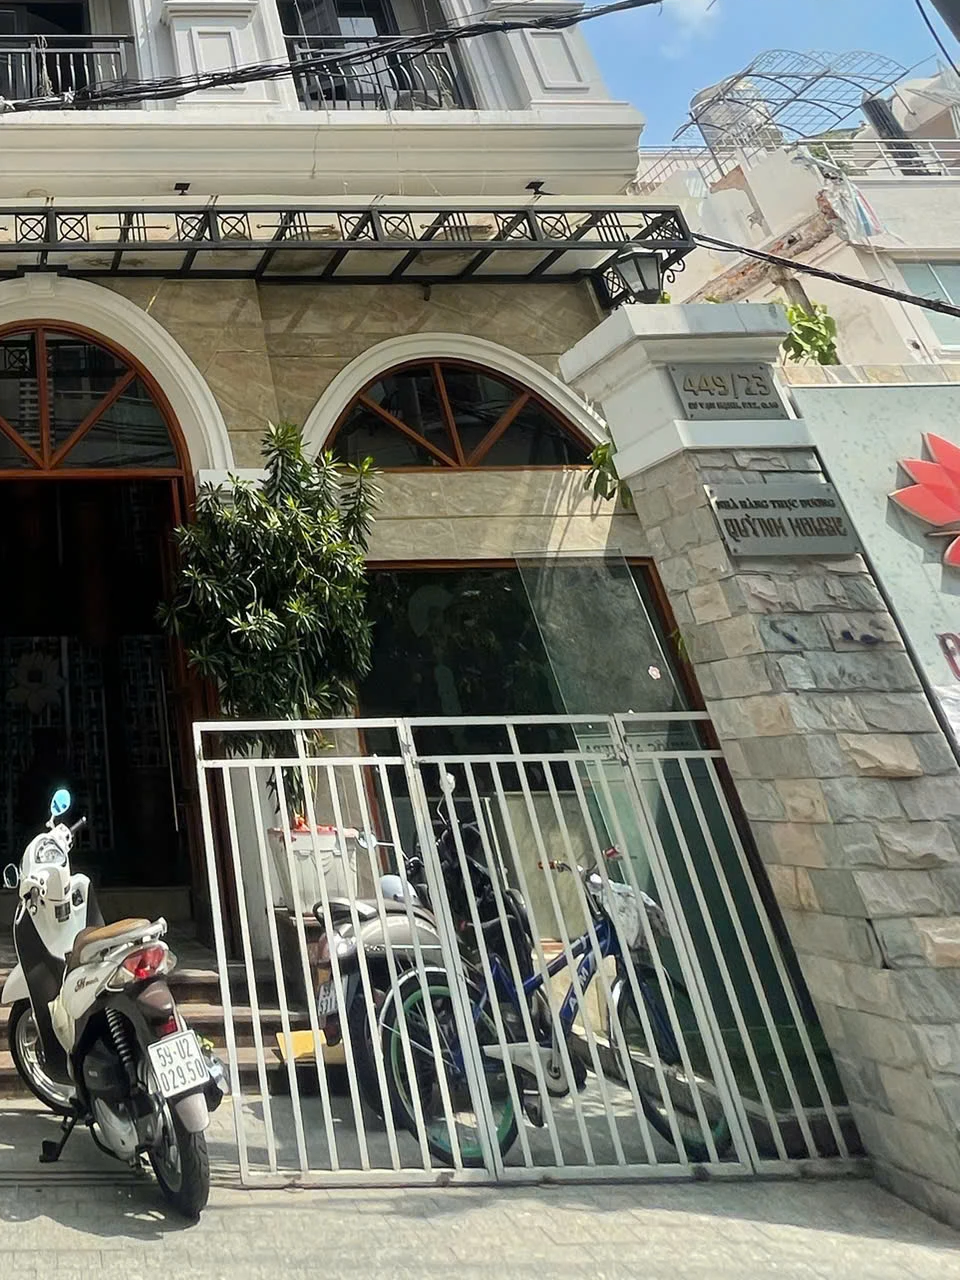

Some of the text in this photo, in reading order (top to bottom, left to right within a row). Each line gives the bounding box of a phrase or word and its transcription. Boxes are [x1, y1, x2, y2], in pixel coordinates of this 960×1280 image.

[683, 373, 772, 399] 449/23
[723, 513, 848, 542] QUỲNH HOUSE
[159, 1058, 205, 1092] 029.50
